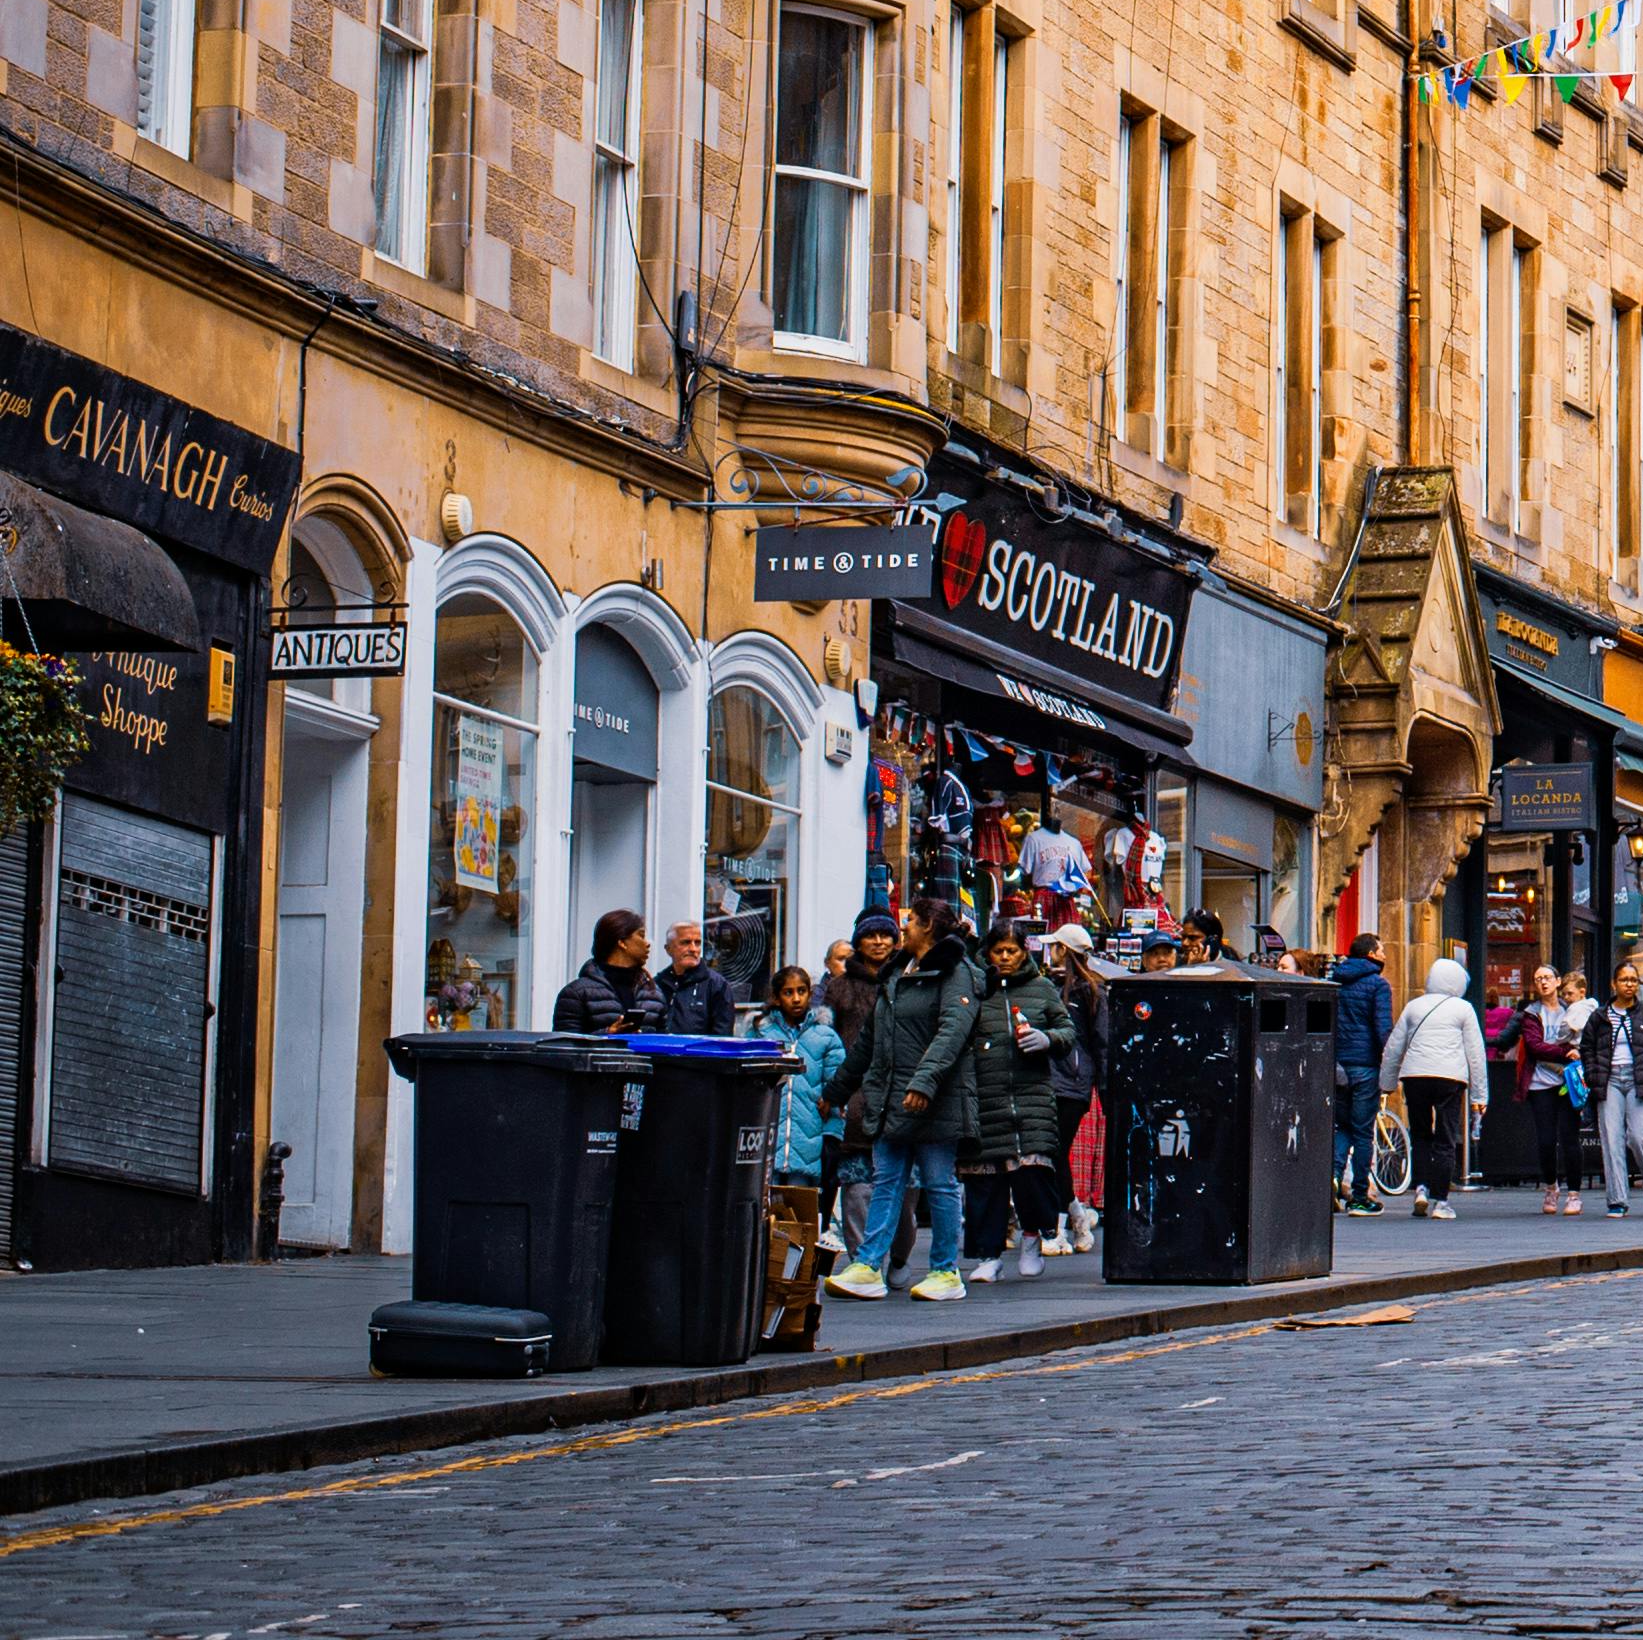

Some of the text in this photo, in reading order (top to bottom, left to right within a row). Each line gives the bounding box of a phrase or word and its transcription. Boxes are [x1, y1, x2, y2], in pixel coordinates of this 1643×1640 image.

[44, 386, 228, 511] CAVANAGH
[229, 474, 275, 522] Curios
[768, 556, 825, 571] TIME
[861, 553, 919, 568] TIDE
[978, 539, 1174, 678] SCOTLAND
[274, 630, 402, 668] ANTIQUES
[101, 683, 168, 754] Shoppe
[605, 712, 630, 734] TIDE
[1032, 688, 1107, 730] SCOTLAND
[1511, 792, 1582, 805] LOCANDA
[1536, 779, 1554, 790] LA
